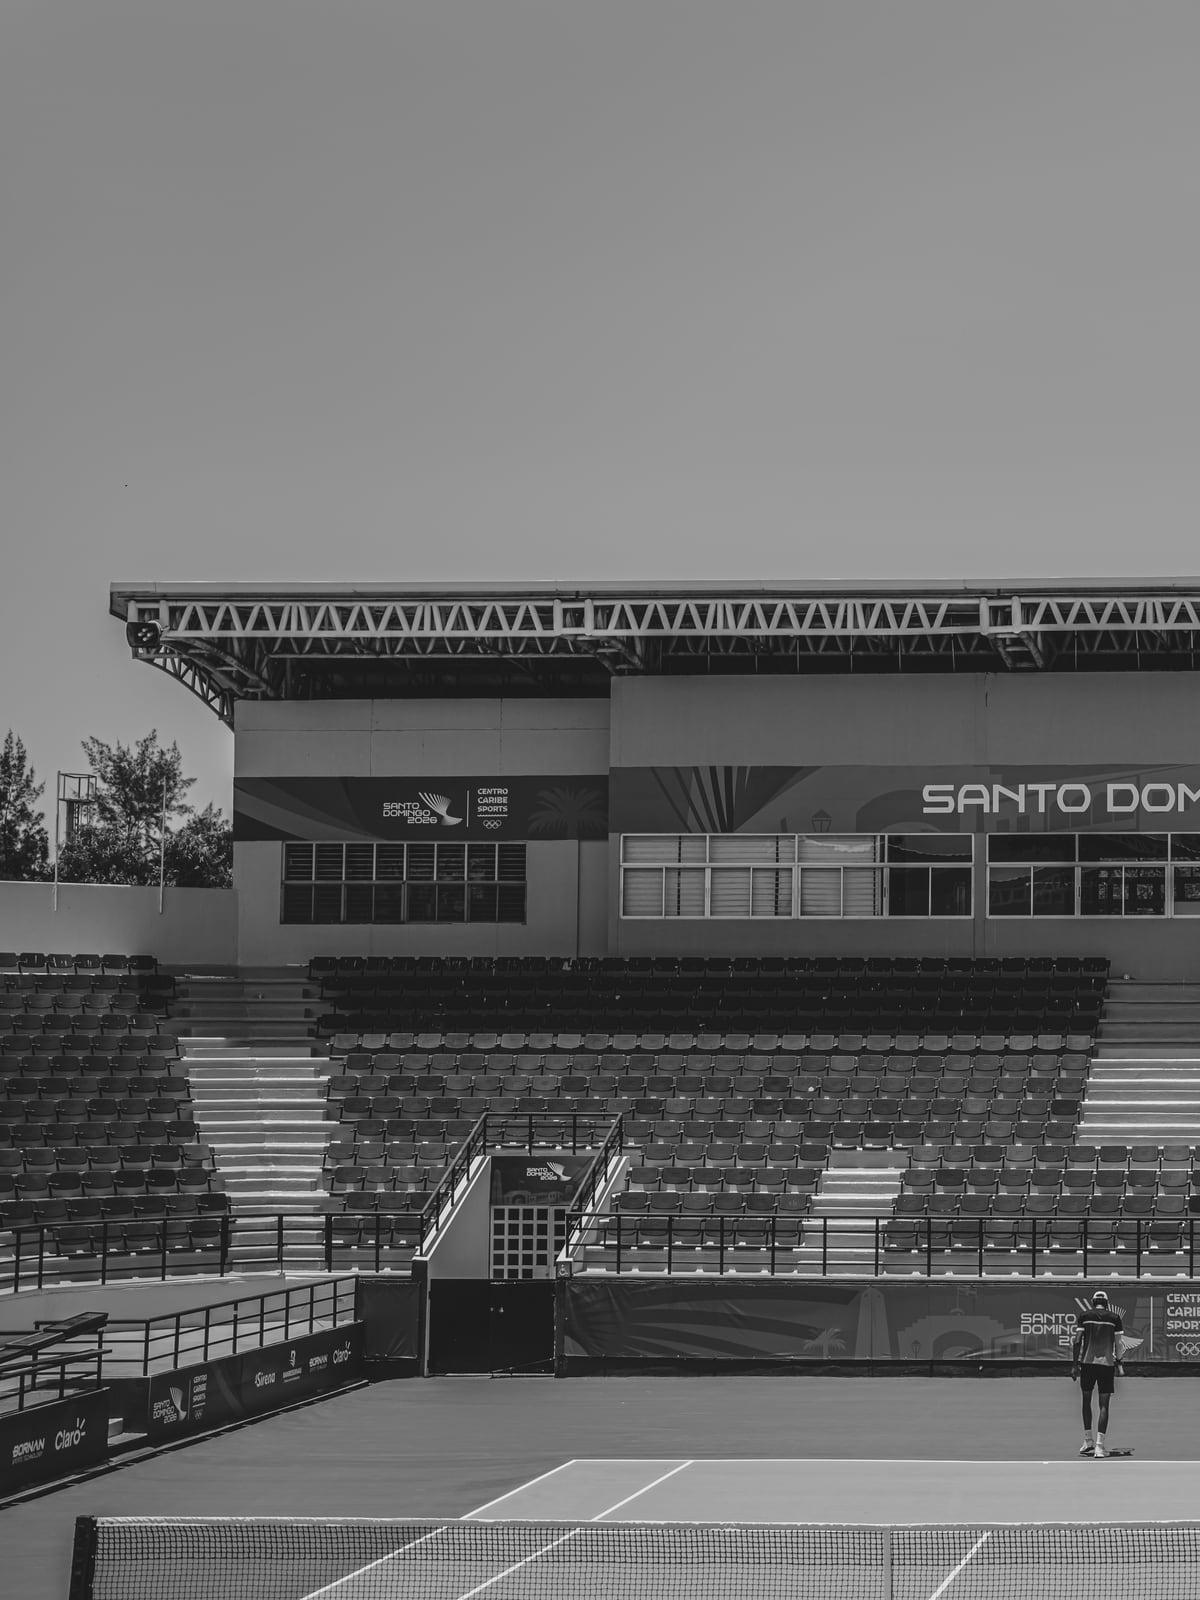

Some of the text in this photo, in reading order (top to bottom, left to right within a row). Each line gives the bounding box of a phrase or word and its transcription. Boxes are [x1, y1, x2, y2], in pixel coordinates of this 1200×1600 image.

[477, 796, 508, 804] CARIBE
[922, 784, 1091, 813] SANTO
[383, 802, 420, 810] SANTO
[382, 809, 431, 817] DOMINGO
[1020, 1313, 1077, 1324] SANTO
[12, 1437, 46, 1458] BORNAN
[55, 1428, 81, 1450] Claro
